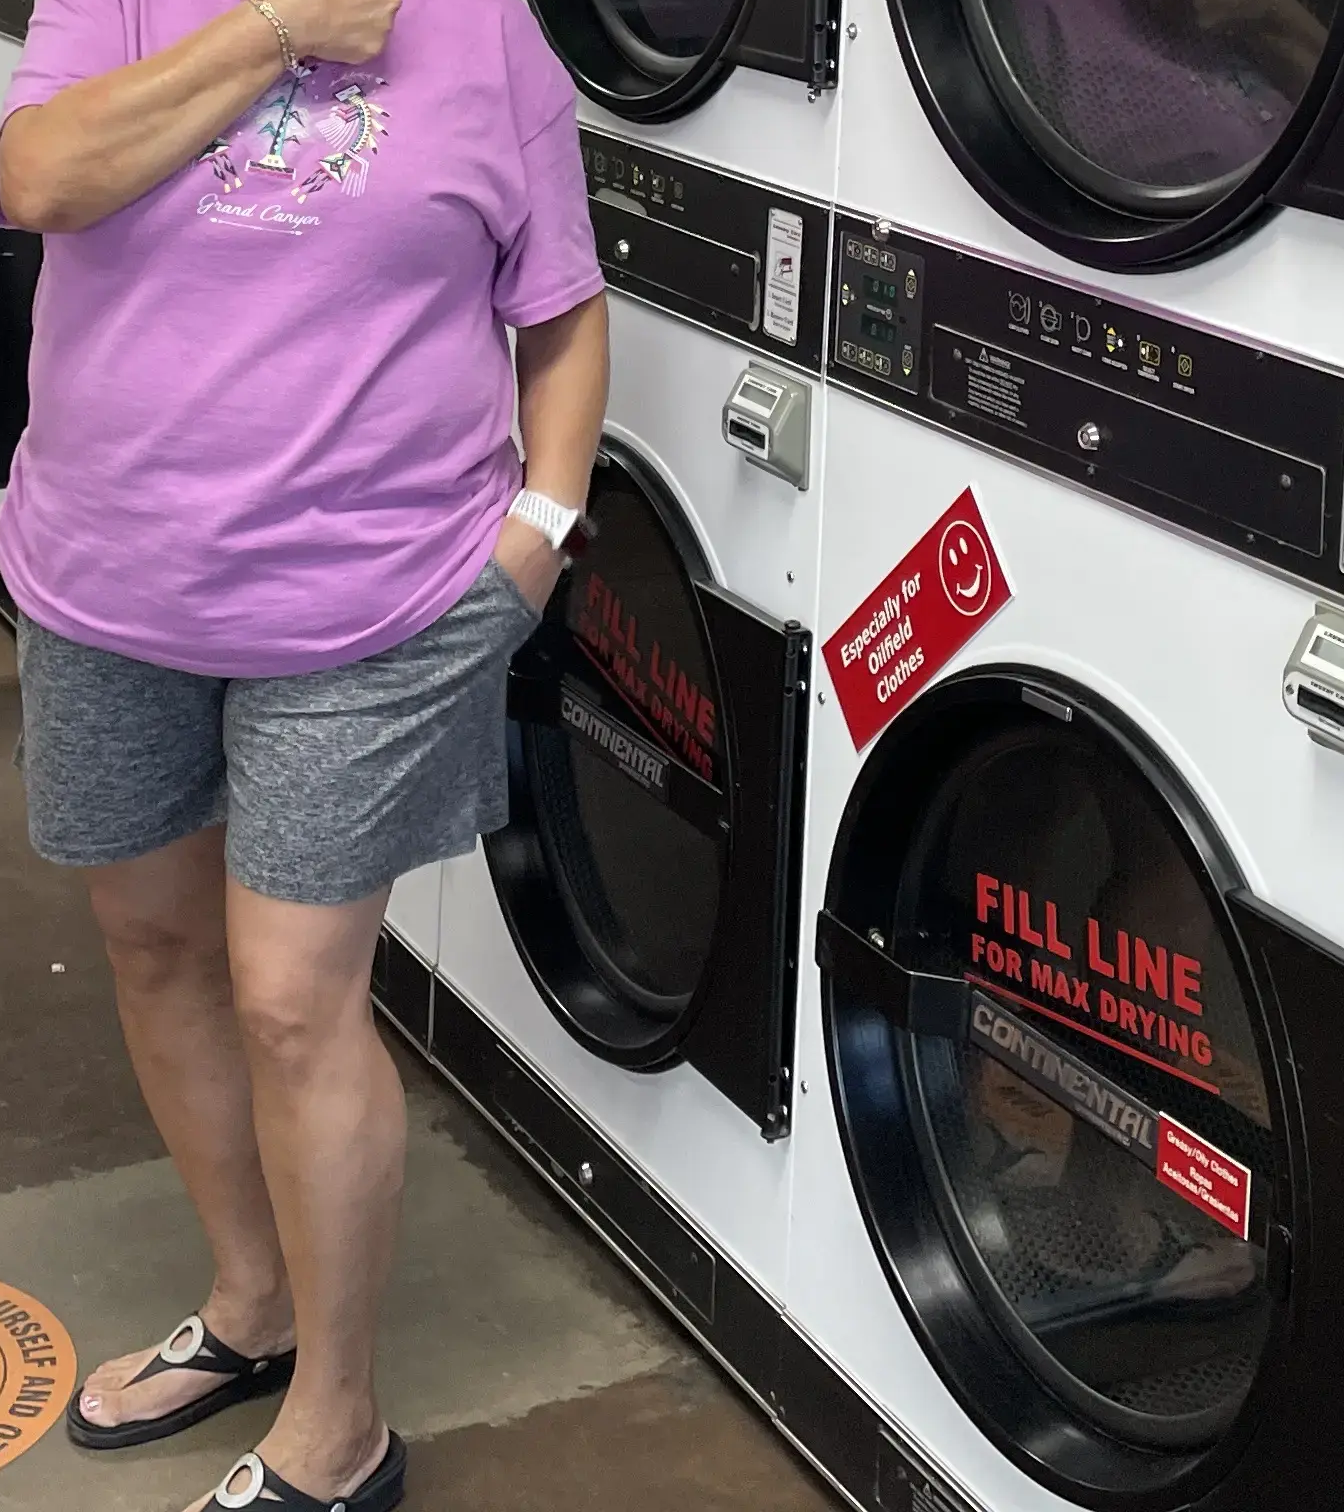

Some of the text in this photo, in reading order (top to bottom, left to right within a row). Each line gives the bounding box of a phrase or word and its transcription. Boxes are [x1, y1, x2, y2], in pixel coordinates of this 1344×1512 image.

[197, 193, 323, 229] Grand Canyon
[586, 572, 716, 748] FILL LINE
[841, 572, 922, 668] Especially for
[867, 615, 914, 676] Oilfield
[876, 645, 925, 704] Clothes
[560, 695, 668, 789] CONTINENTAL
[649, 693, 714, 783] DRYING
[976, 872, 1203, 1017] FILL LINE
[971, 932, 1213, 1067] FOR MAX DRYING
[972, 1003, 1153, 1150] CONTINENTAL
[8, 1374, 57, 1420] AND
